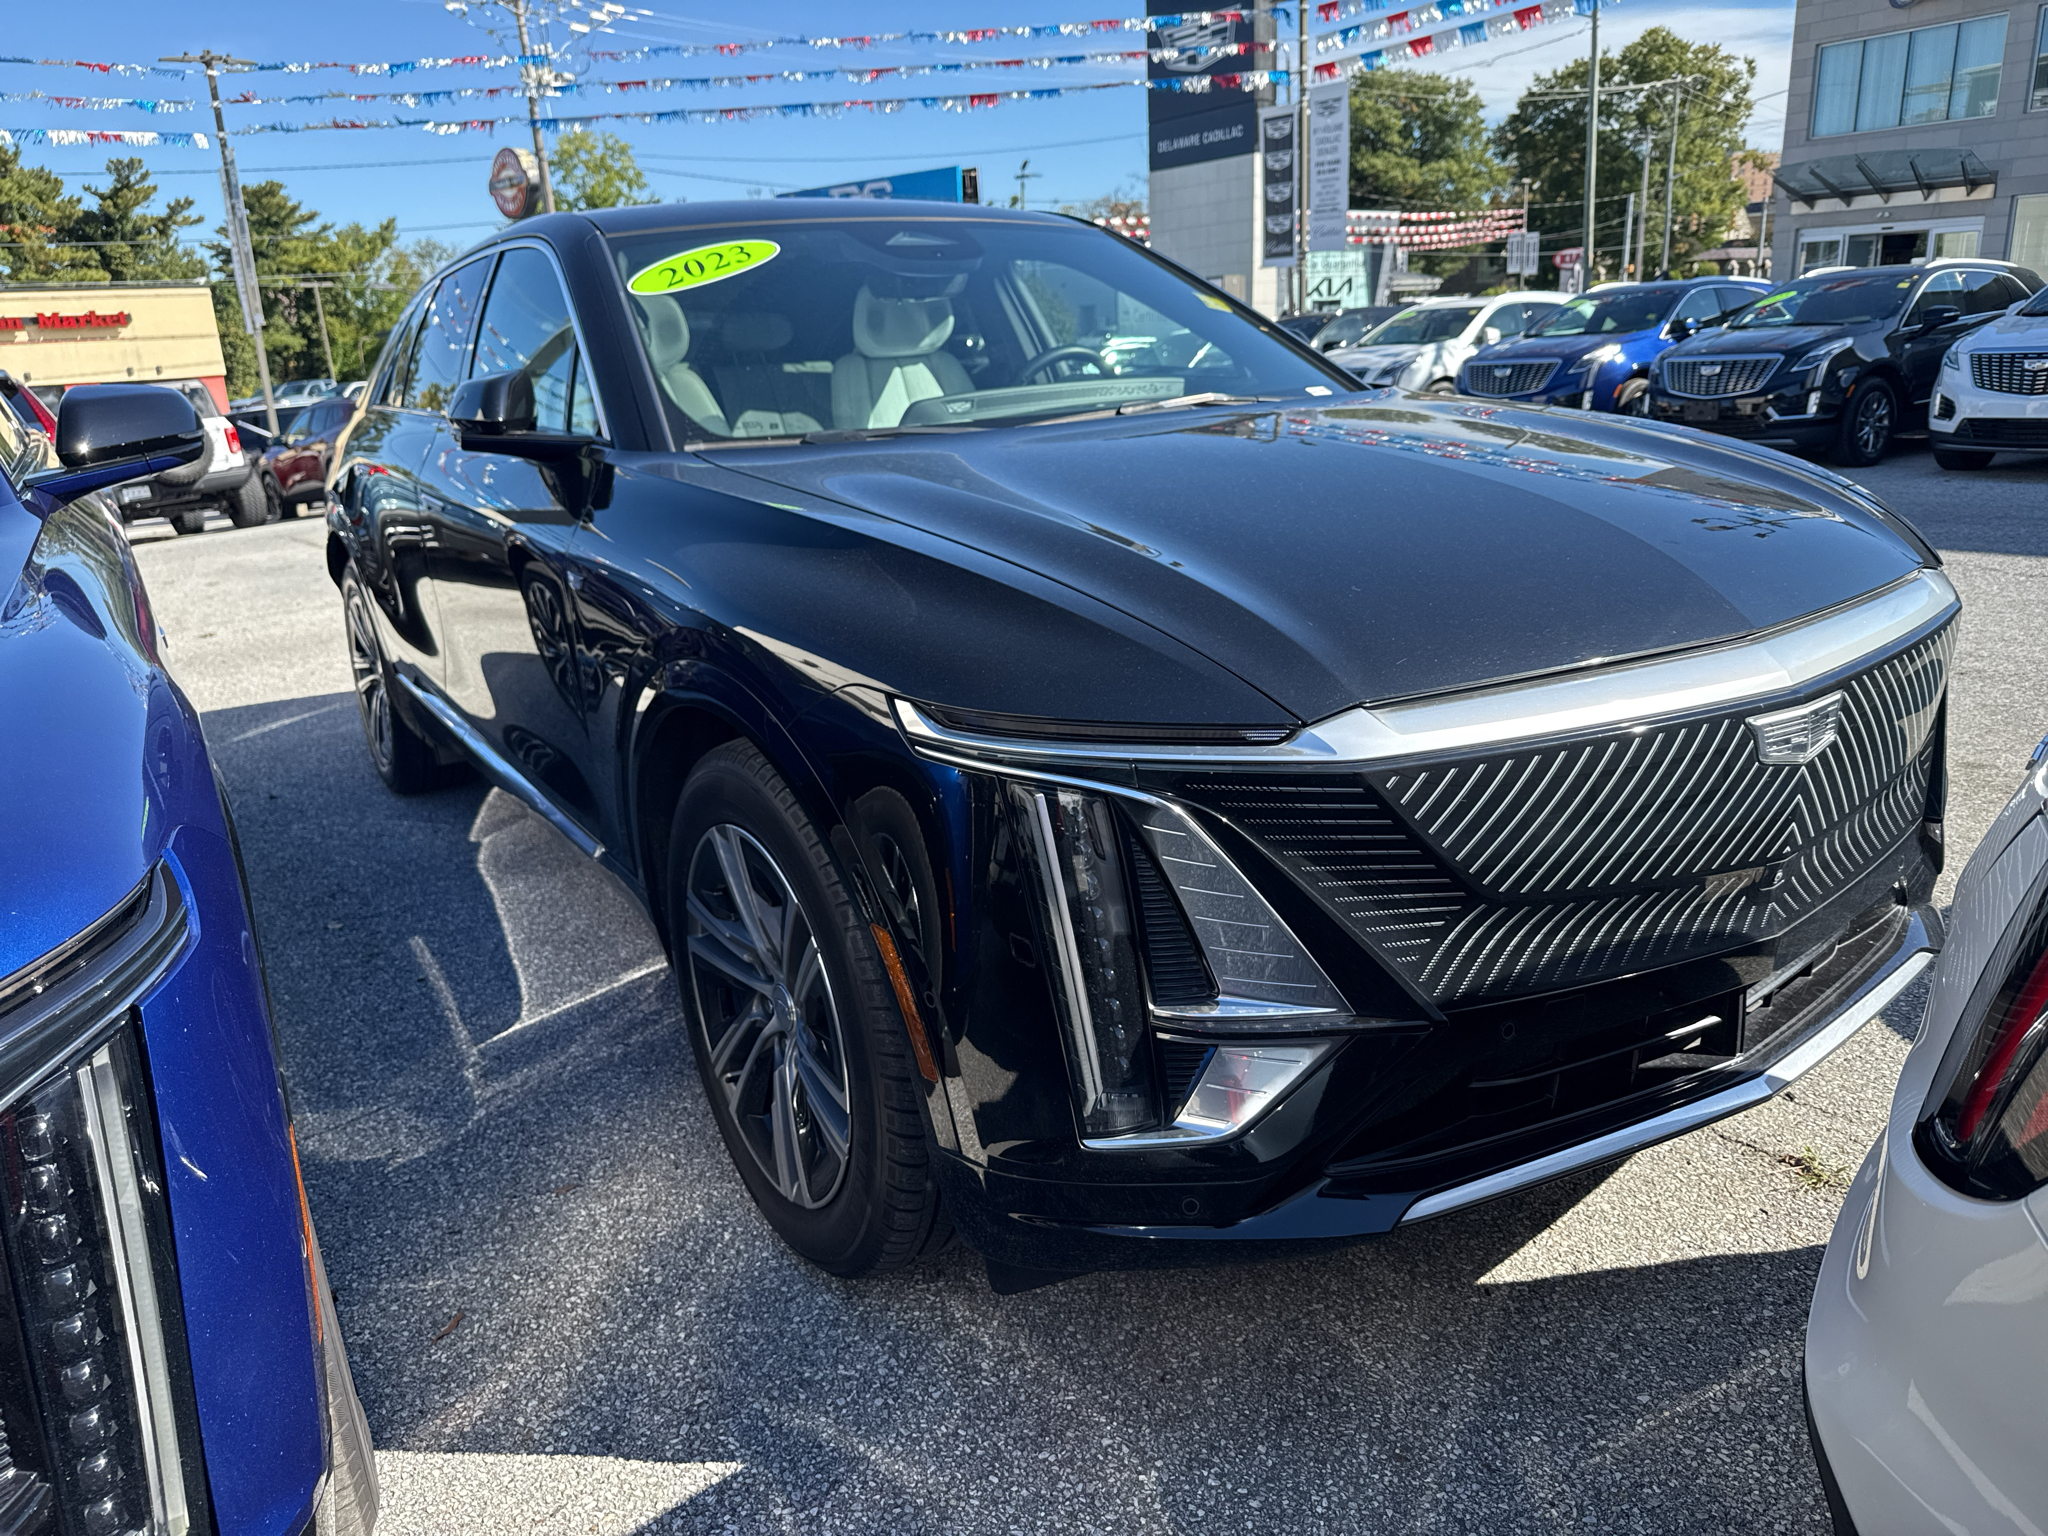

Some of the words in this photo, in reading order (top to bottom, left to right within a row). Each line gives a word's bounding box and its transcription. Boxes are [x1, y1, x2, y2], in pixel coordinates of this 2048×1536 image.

[1157, 132, 1201, 154] DELAWARE
[1202, 123, 1244, 145] CADILLAC
[658, 245, 753, 288] 2023
[36, 310, 129, 330] Market
